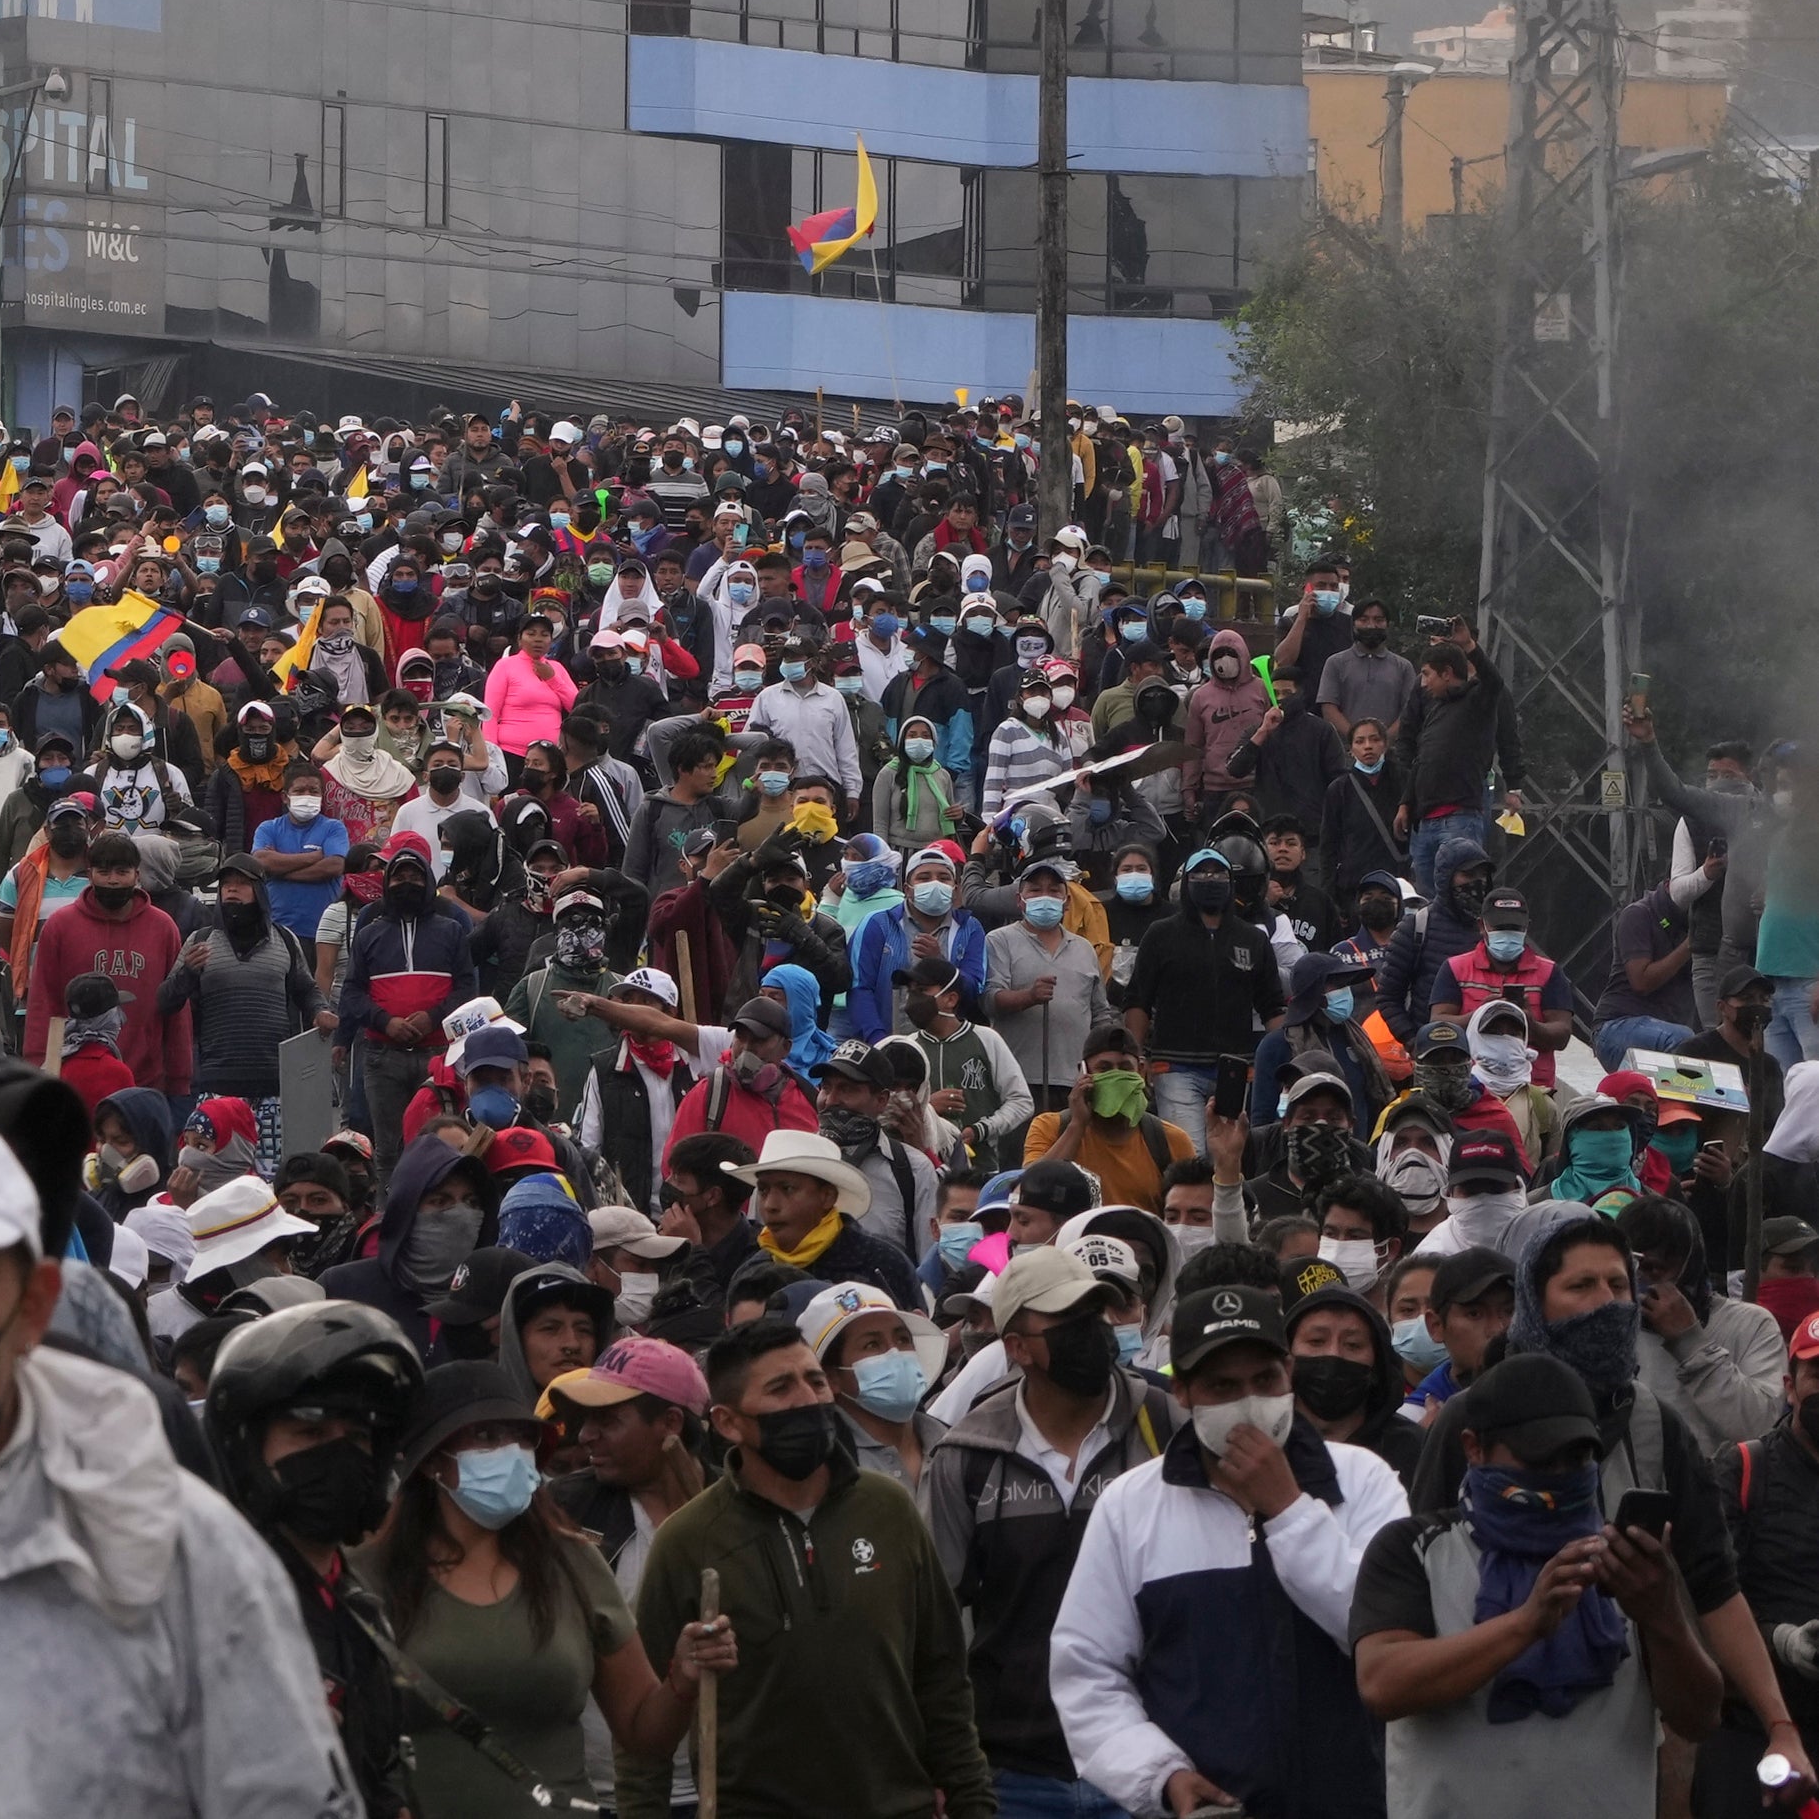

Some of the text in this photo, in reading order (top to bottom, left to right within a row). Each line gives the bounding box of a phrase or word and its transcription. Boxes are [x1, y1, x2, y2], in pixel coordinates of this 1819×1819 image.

[86, 220, 142, 263] M&C
[94, 948, 145, 979] GAP
[1088, 1253, 1109, 1267] 05
[1220, 1318, 1261, 1330] AMG
[970, 1480, 1054, 1507] Calvin
